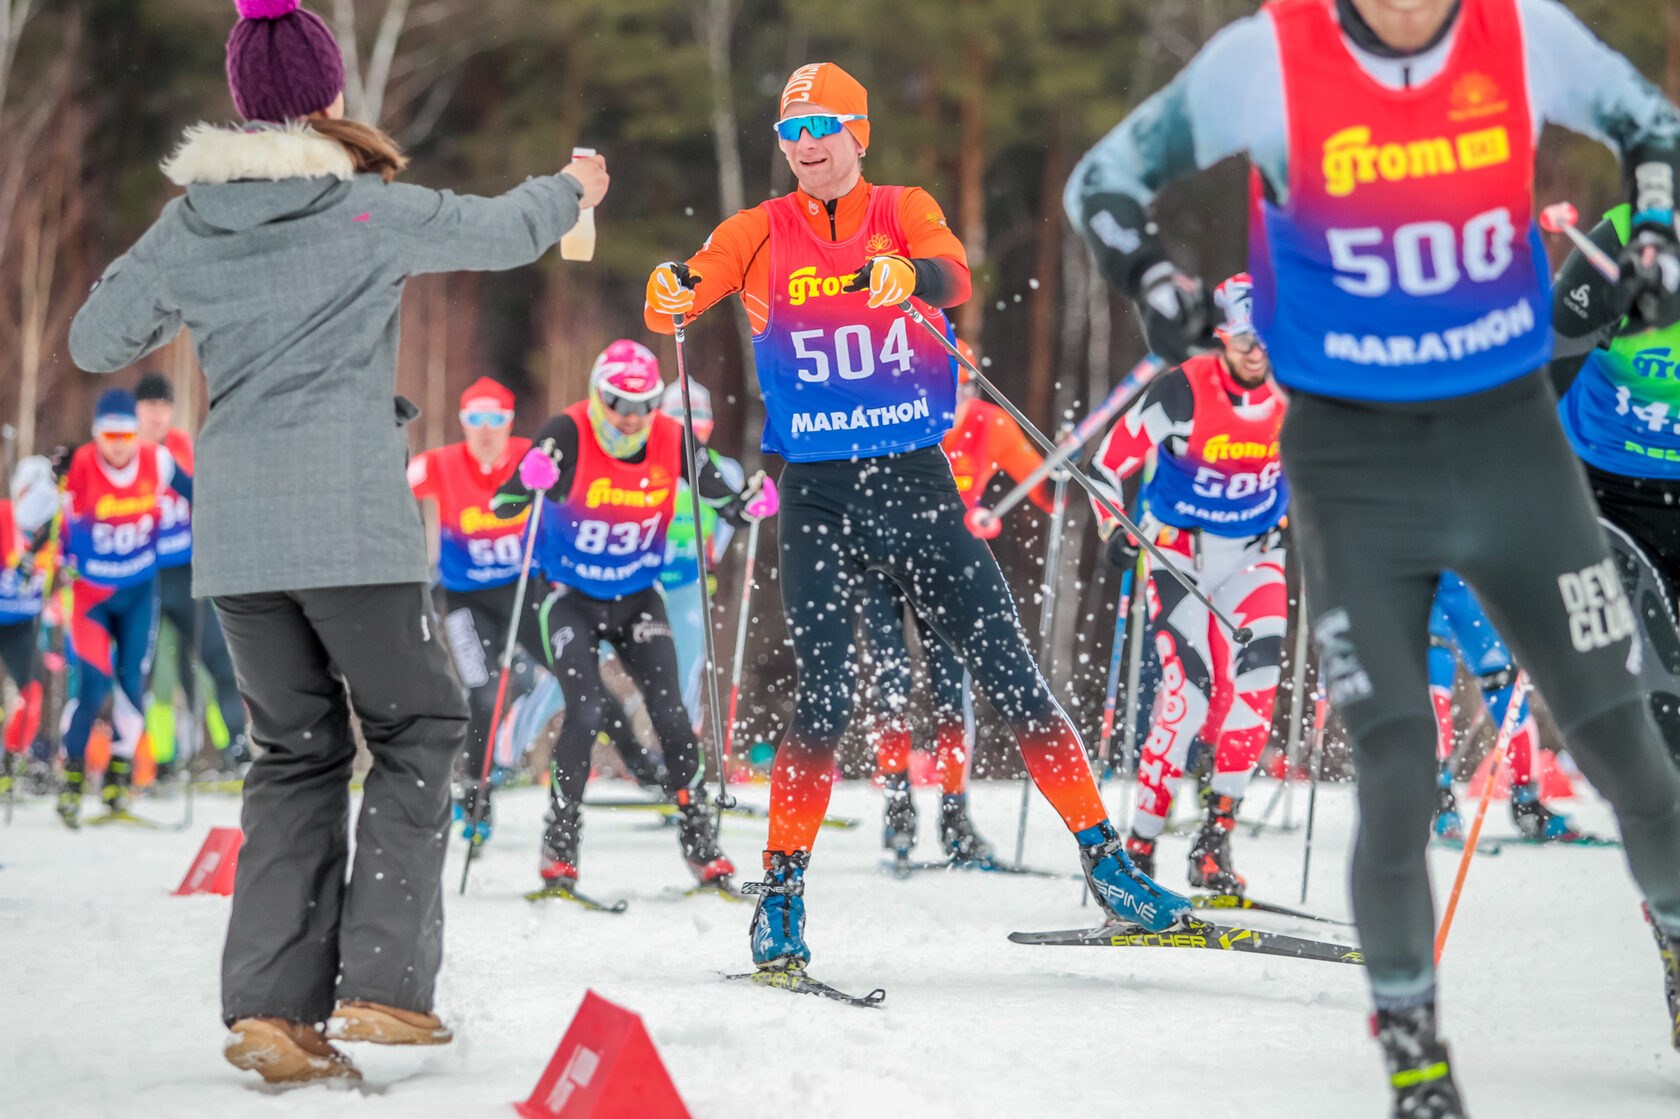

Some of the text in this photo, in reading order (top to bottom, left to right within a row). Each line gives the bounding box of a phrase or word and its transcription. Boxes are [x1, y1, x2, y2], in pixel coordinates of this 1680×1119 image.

[1322, 125, 1457, 197] grom
[790, 317, 914, 383] 504
[1324, 298, 1534, 366] MARATHON
[791, 397, 930, 433] MARATHON
[1202, 433, 1268, 464] grom
[586, 477, 646, 508] grom
[574, 511, 662, 555] 837
[1092, 879, 1158, 925] SPINE
[1110, 934, 1207, 949] FISCHER
